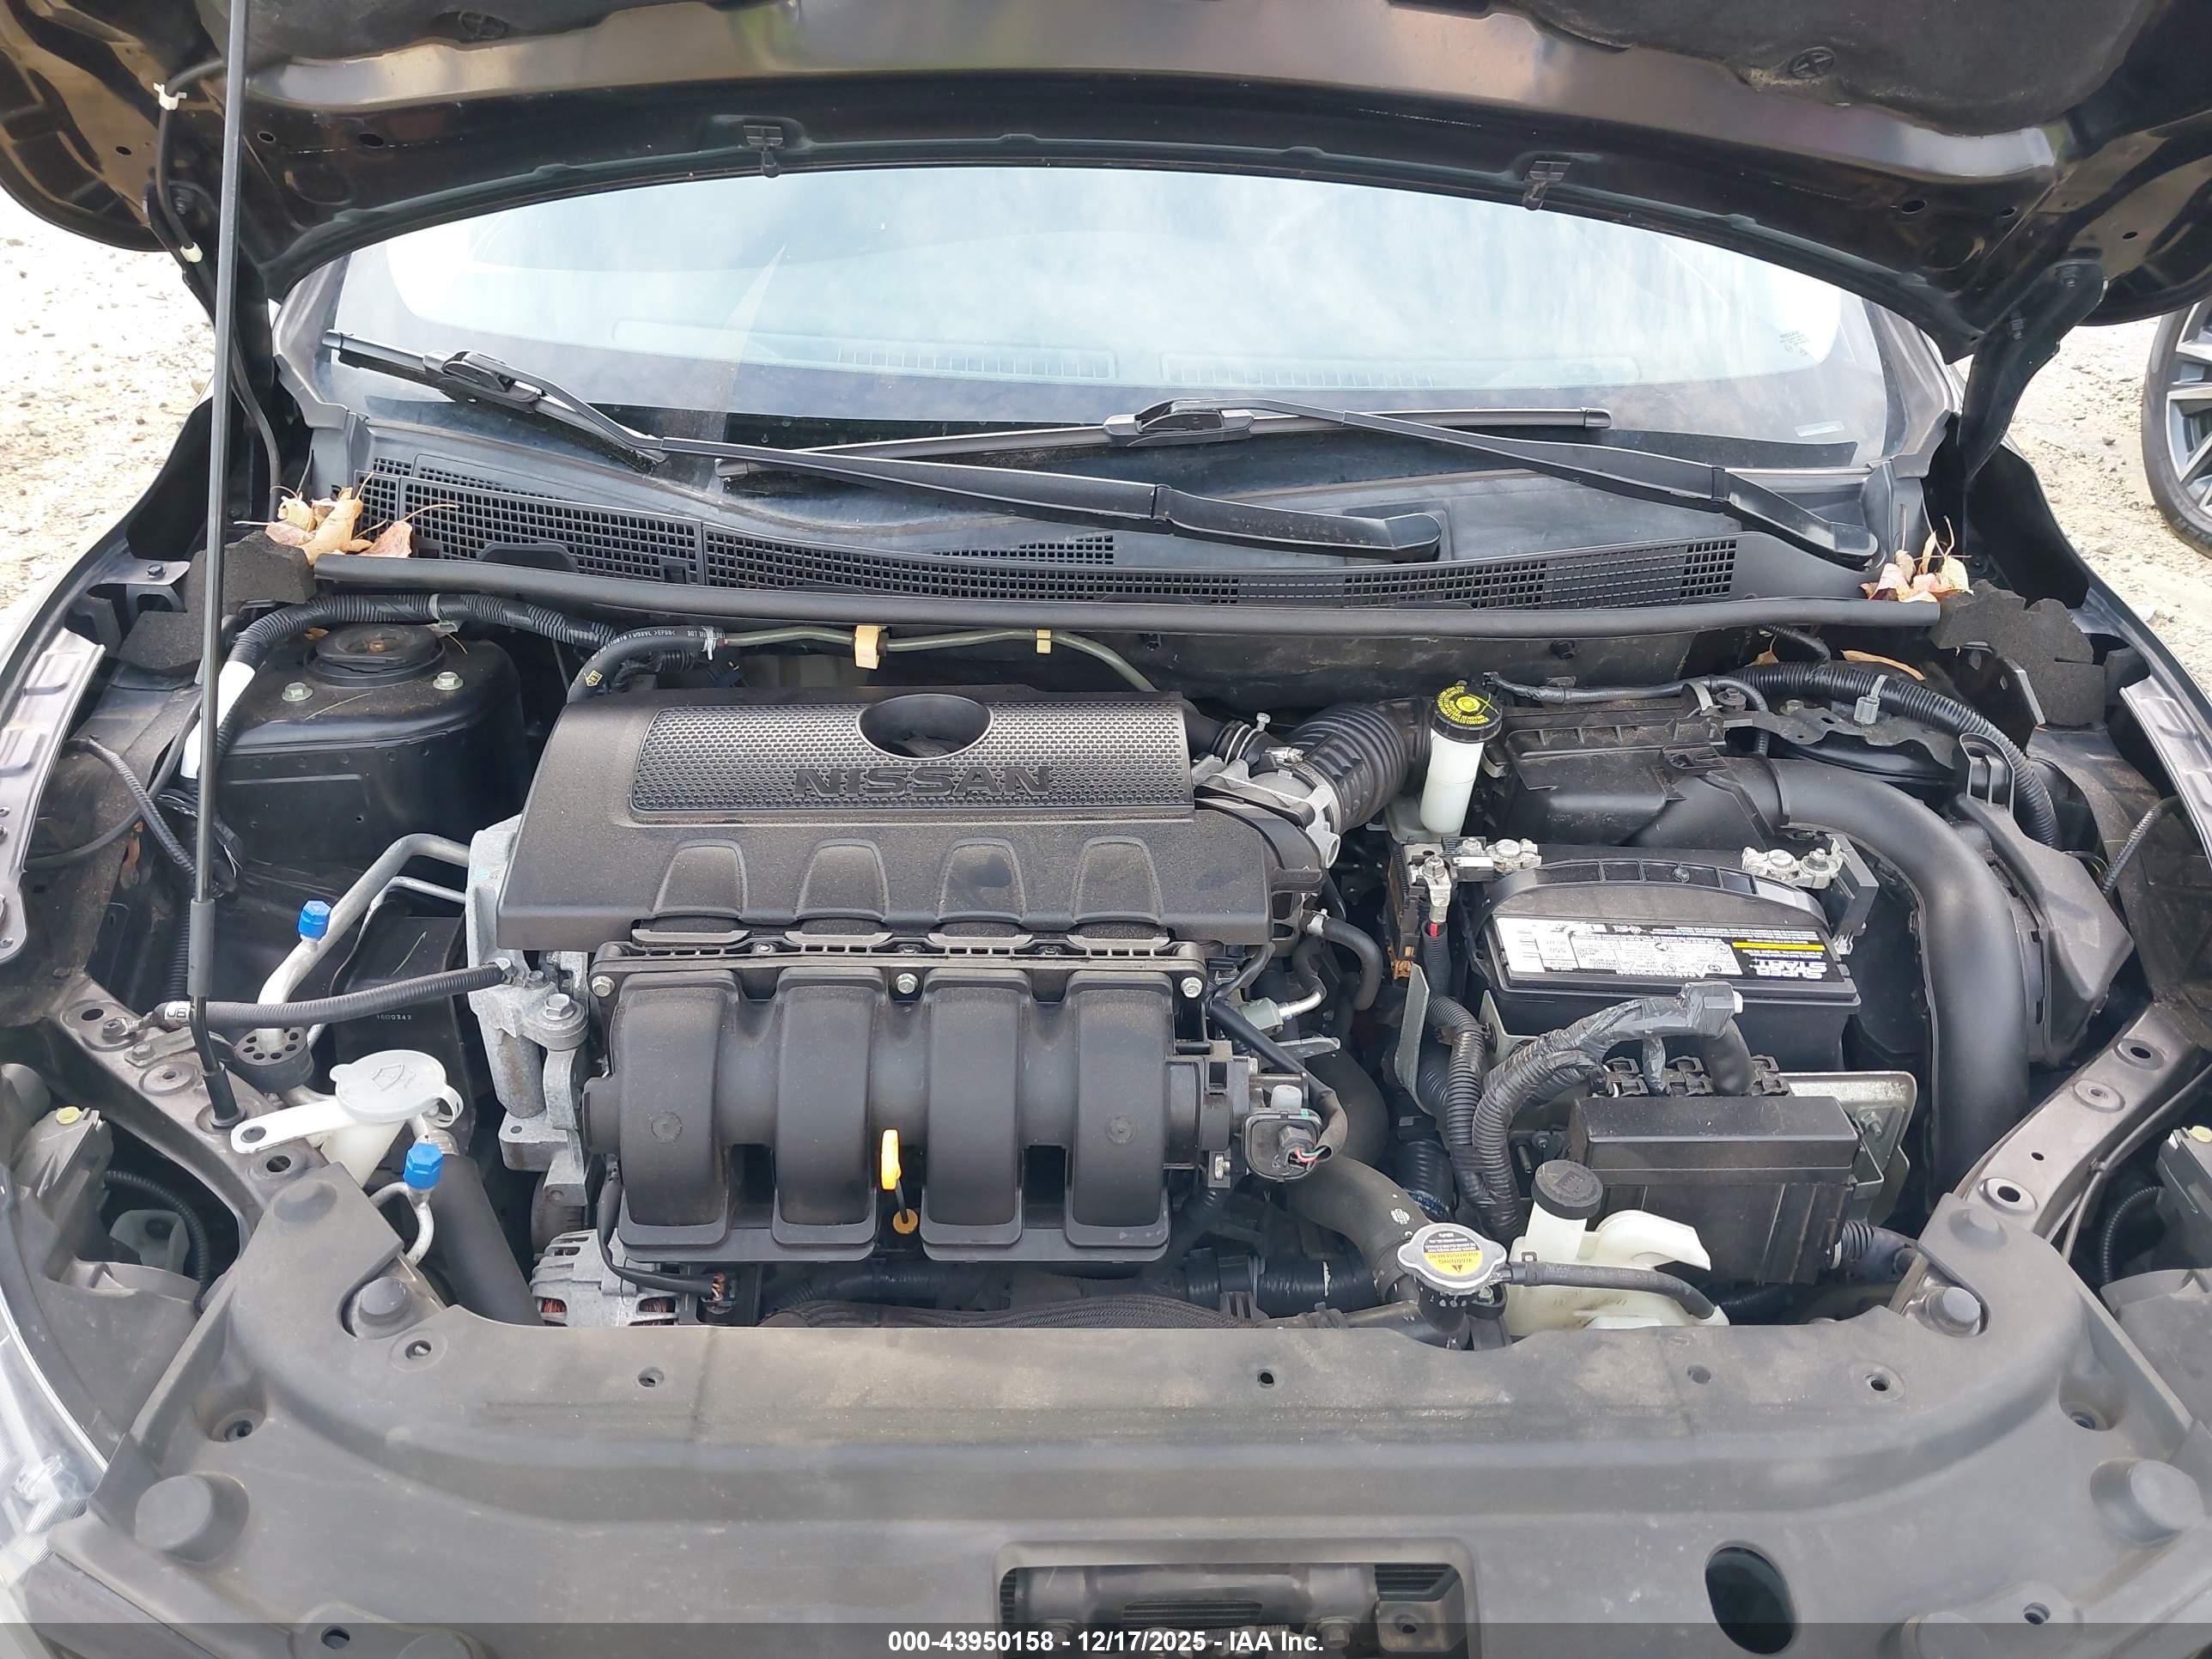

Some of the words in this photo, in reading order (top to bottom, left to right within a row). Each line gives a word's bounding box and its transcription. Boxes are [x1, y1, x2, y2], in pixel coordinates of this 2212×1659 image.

[793, 766, 1051, 797] NISSAN
[1756, 961, 1827, 972] START
[1757, 968, 1822, 980] SUPER
